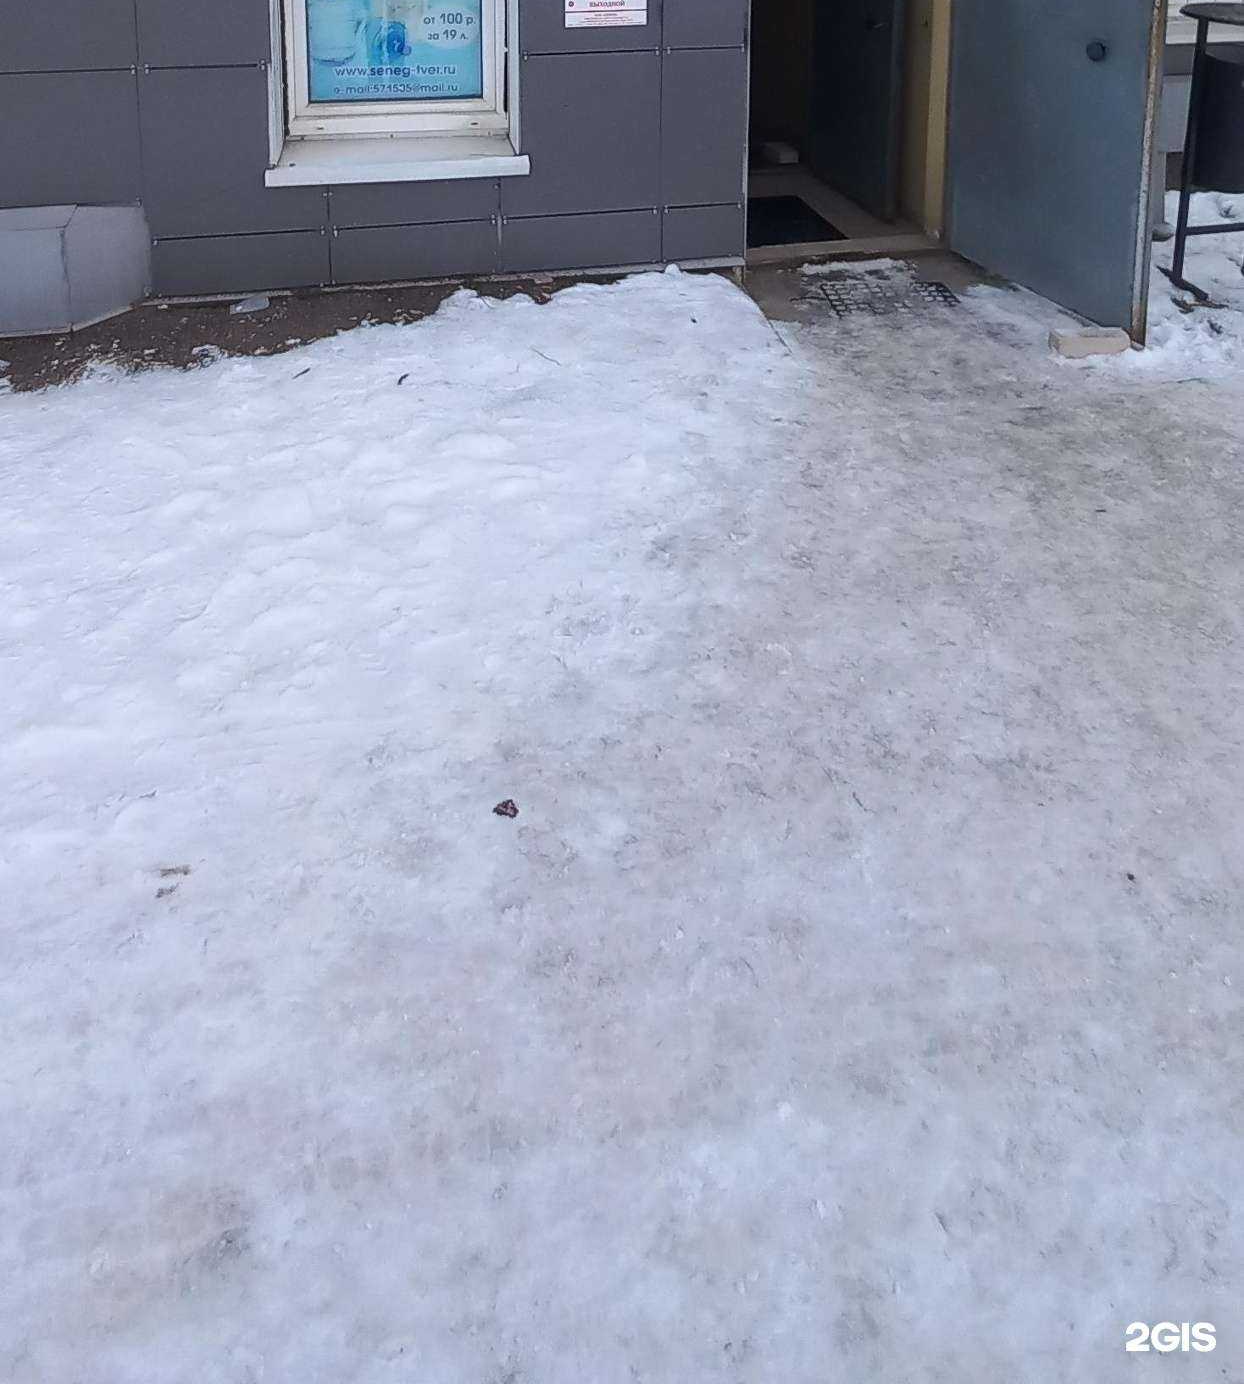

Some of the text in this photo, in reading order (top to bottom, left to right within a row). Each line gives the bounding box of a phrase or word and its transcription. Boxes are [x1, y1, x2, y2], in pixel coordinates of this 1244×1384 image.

[423, 12, 477, 26] от 100 р.
[427, 32, 440, 41] за
[442, 29, 457, 41] 19
[334, 65, 457, 78] www.seneg-tver.ru
